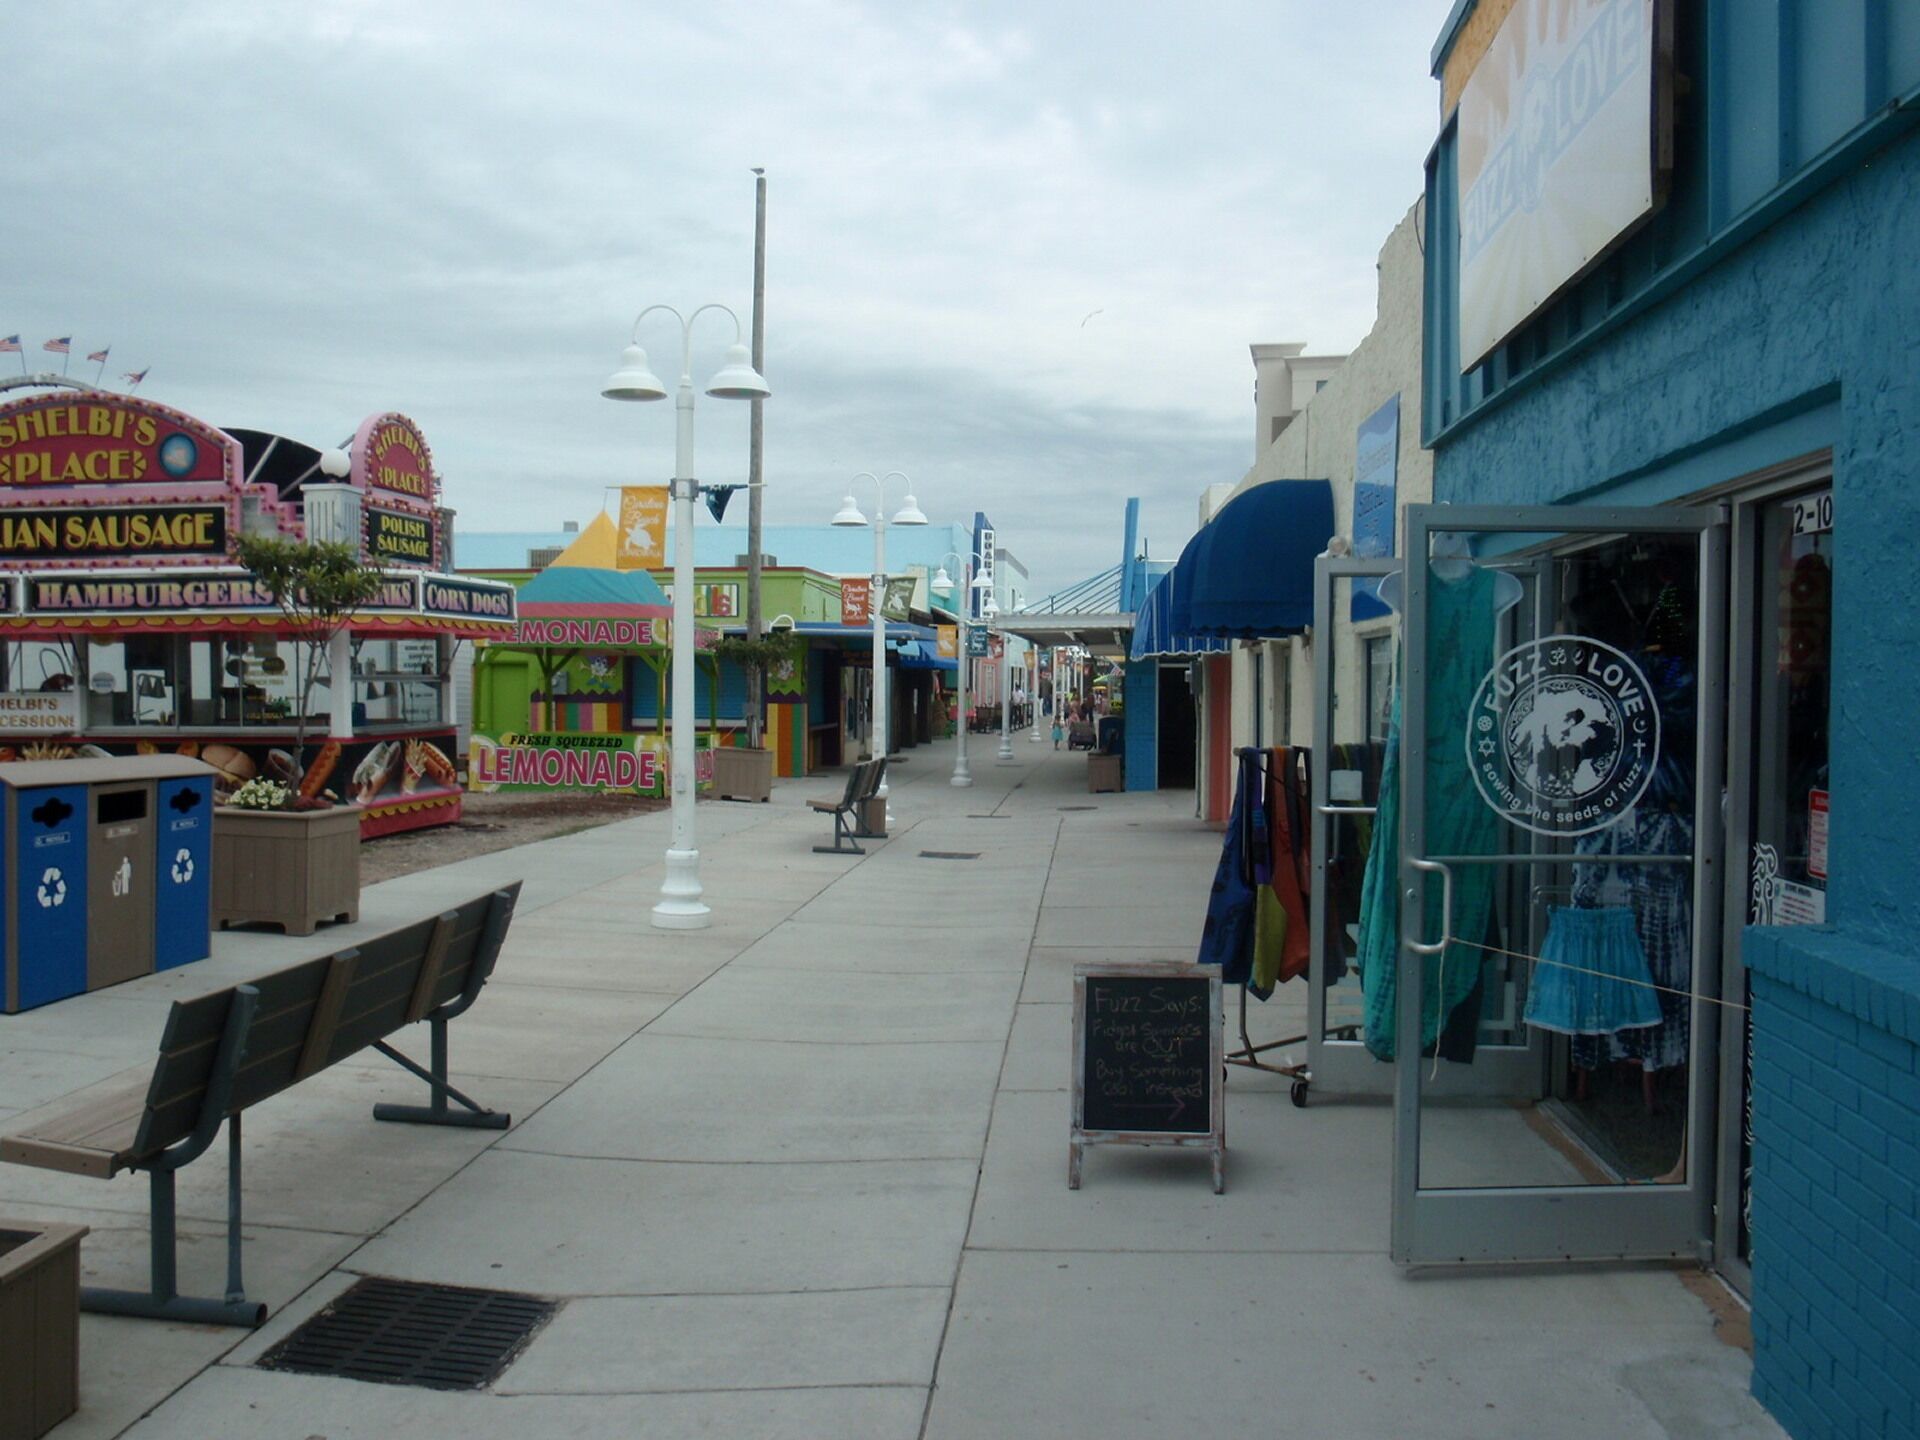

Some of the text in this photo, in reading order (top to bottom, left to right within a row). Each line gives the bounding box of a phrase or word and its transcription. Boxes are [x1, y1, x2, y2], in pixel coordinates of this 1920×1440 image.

[1554, 0, 1641, 148] LOVE
[0, 406, 157, 447] SHELBI'S
[15, 449, 131, 483] PLACE
[375, 425, 427, 471] SHELBI'S
[383, 469, 422, 495] PLACE
[0, 513, 214, 549] IAN SAUSAGE
[380, 514, 426, 538] POLISH
[1794, 495, 1834, 534] 2-10
[377, 535, 429, 557] SAUSAGE
[36, 580, 274, 609] HAMBURGERS
[426, 583, 508, 616] CORN DOGS
[1484, 650, 1645, 717] FUZZ LOVE
[510, 734, 623, 748] FRESH SQUEEZED
[477, 747, 656, 789] LEMONADE
[1482, 761, 1643, 823] sowing the seeds of fuzz
